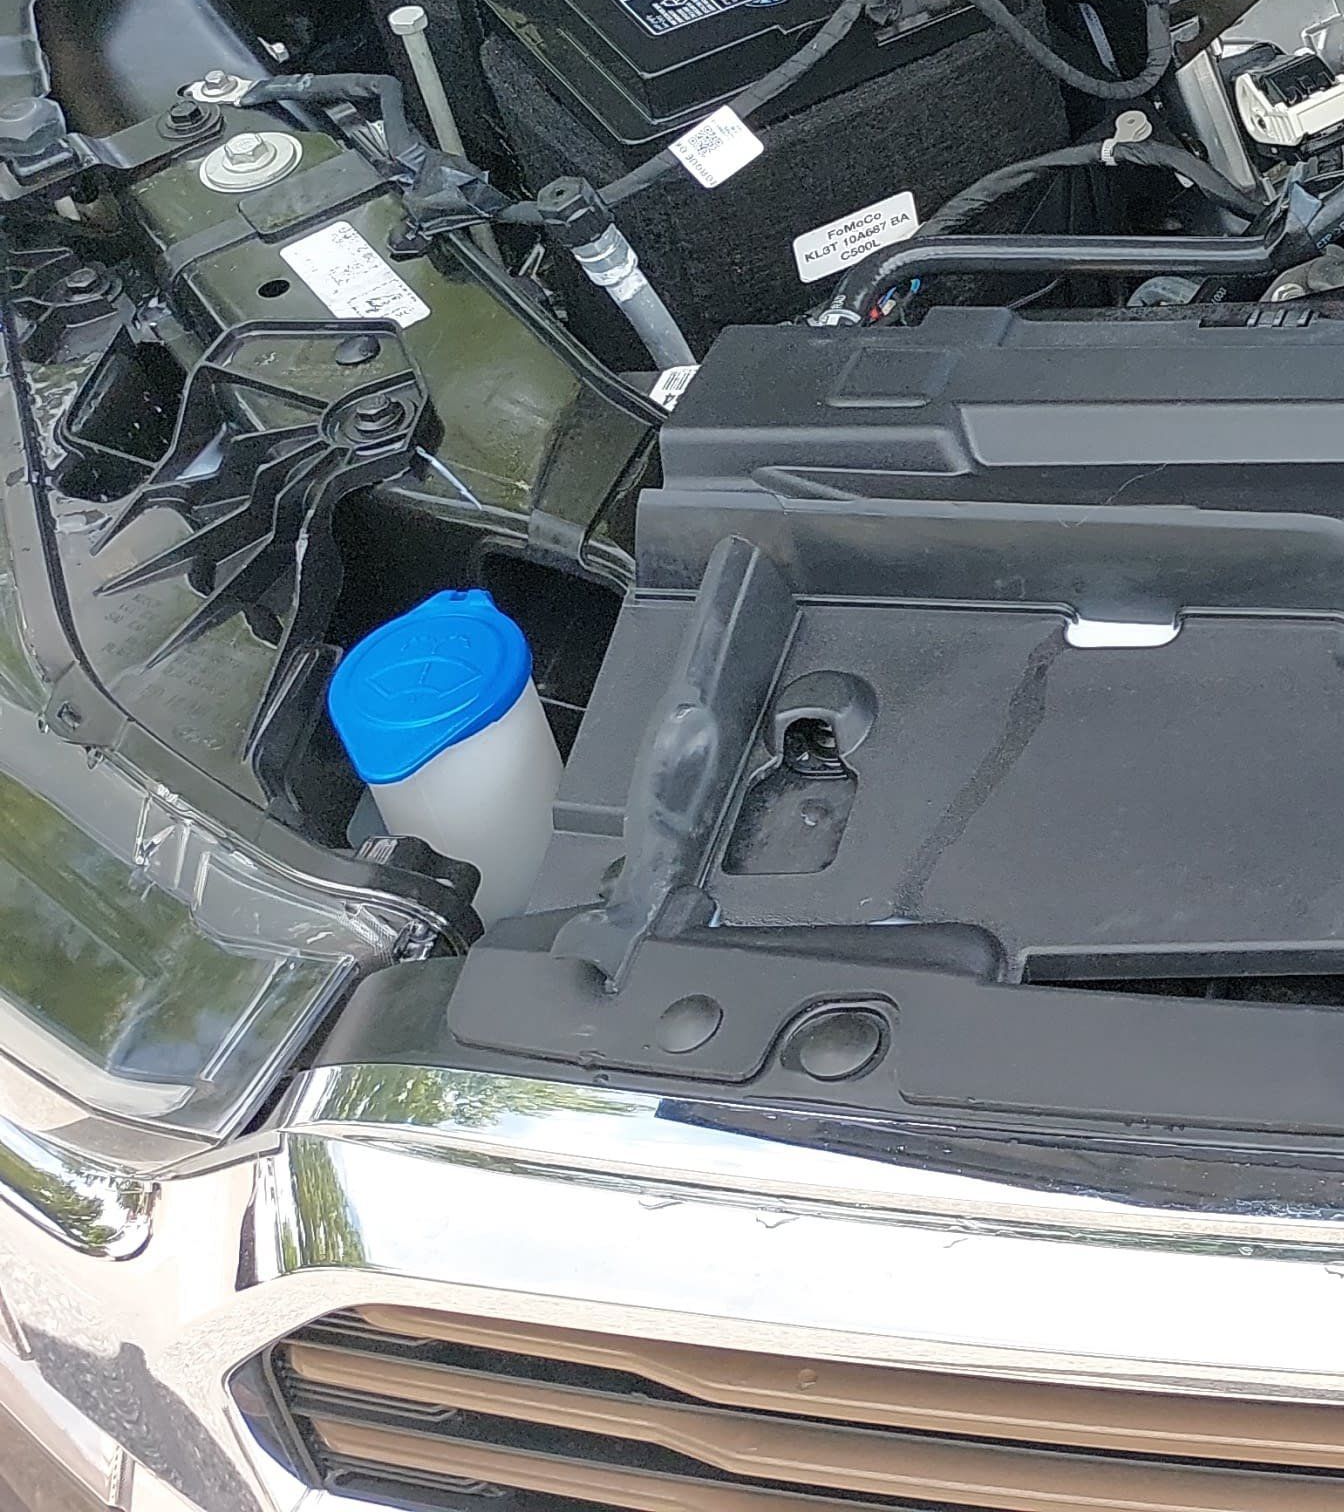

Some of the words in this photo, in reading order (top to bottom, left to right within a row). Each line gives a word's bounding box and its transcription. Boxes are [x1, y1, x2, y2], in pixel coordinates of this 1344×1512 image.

[827, 212, 882, 240] FoMoCo
[843, 221, 887, 246] 10A687
[840, 239, 881, 261] C500L
